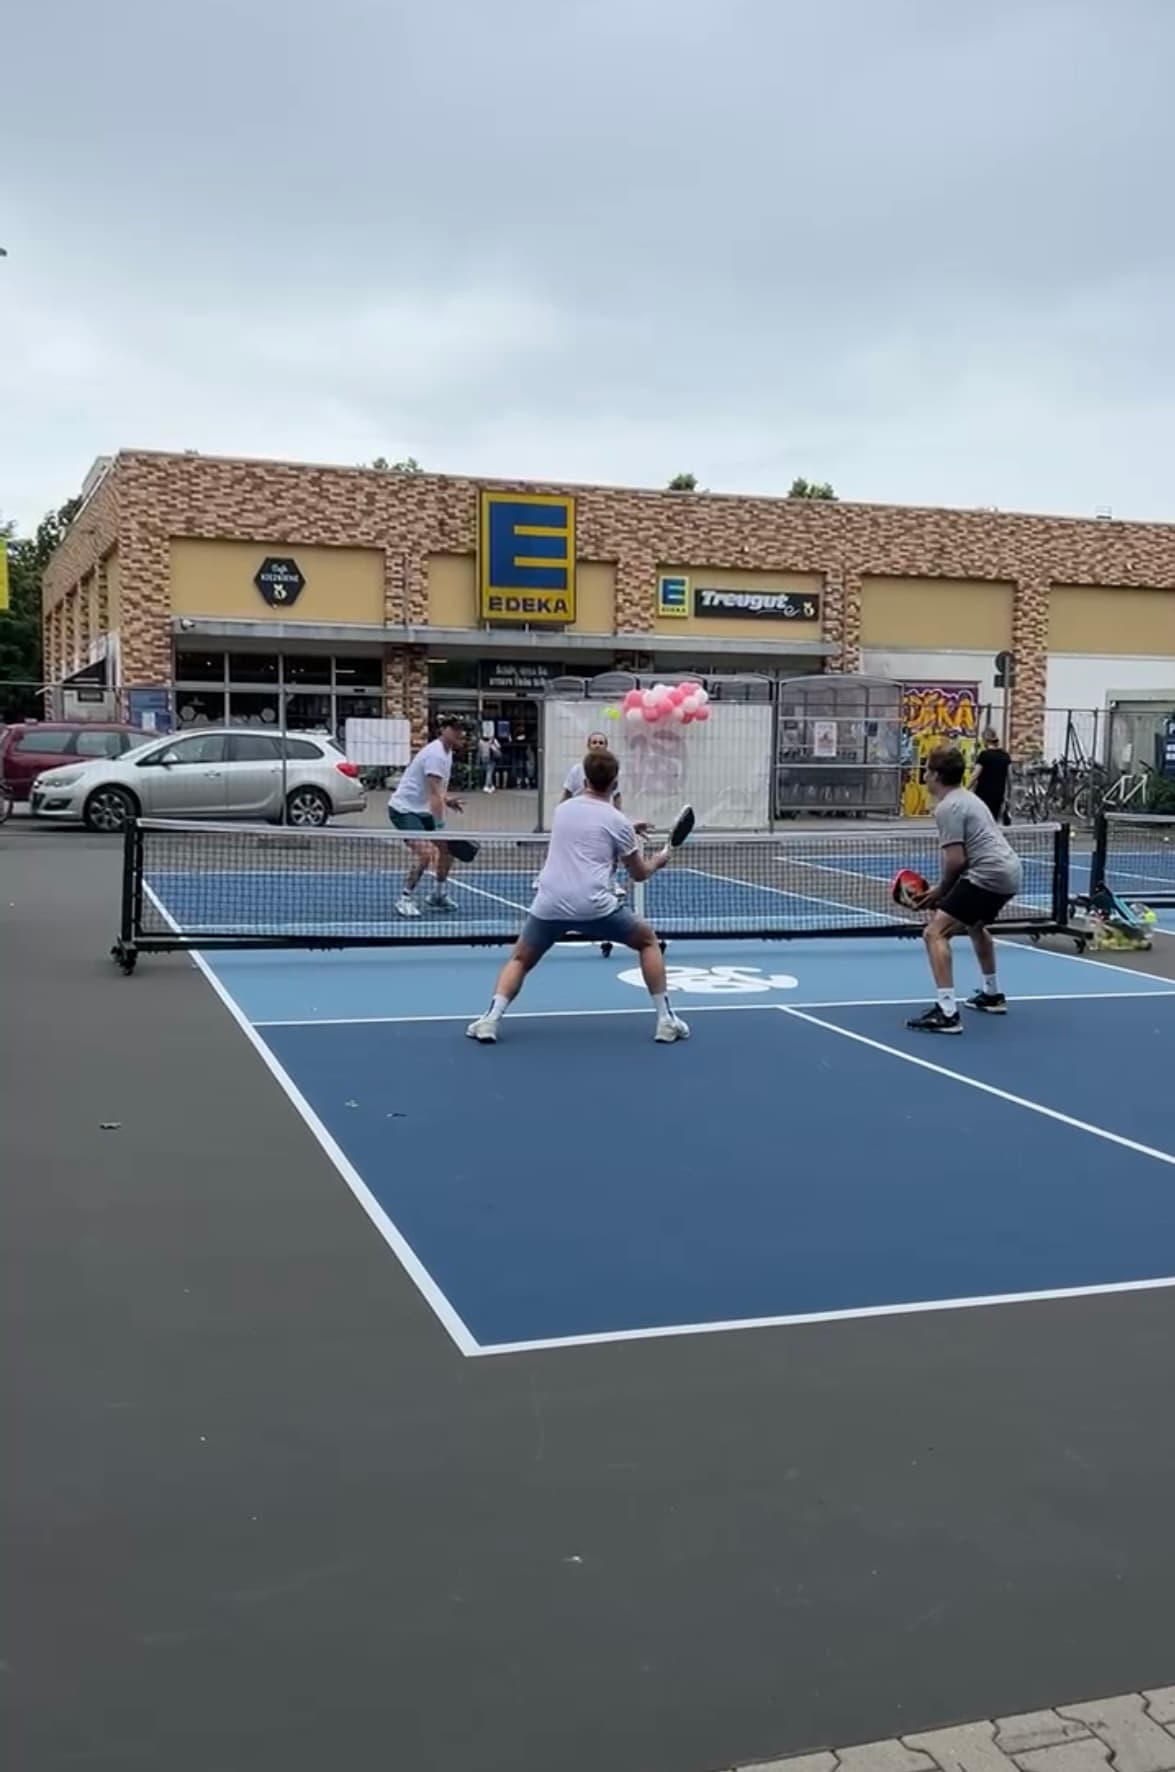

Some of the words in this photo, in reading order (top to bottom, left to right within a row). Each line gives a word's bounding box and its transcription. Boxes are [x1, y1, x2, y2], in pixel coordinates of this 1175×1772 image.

[489, 501, 568, 589] E
[662, 579, 685, 605] E
[701, 590, 789, 610] Treugut
[488, 596, 568, 614] EDEKA
